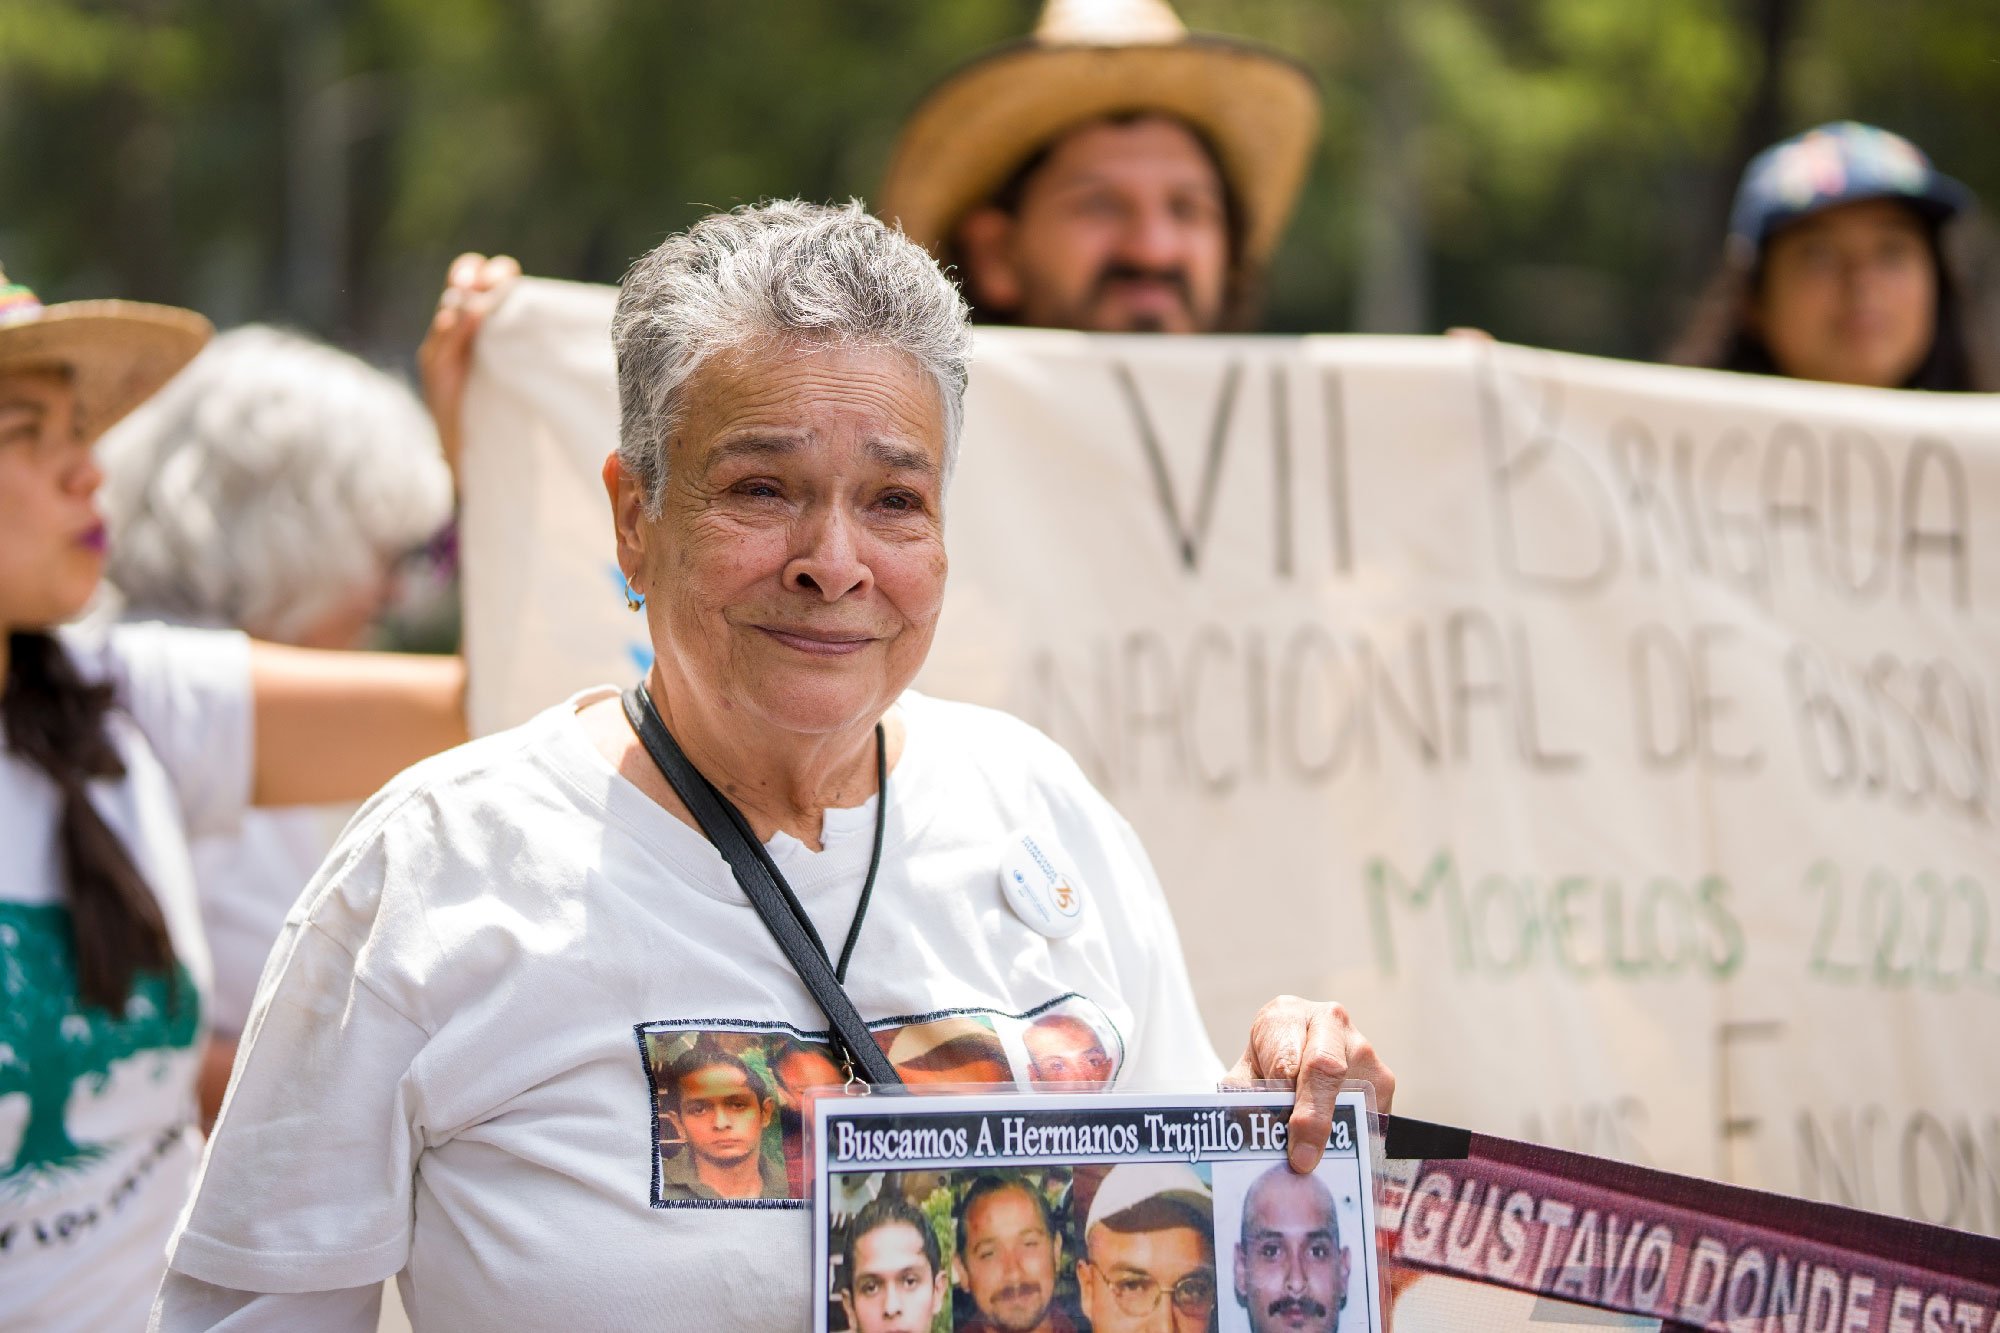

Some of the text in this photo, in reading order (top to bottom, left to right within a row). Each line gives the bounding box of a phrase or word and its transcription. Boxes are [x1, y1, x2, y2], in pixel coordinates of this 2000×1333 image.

[1113, 350, 1974, 614] VII BRIGADA
[1030, 609, 1585, 796] NACIONAL
[1628, 620, 1764, 773] DE
[836, 1109, 1353, 1164] Buscamos A Hermanos Trujillo Hera
[1399, 1172, 1676, 1312] GUSTAVO
[1680, 1236, 1878, 1333] DONDE
